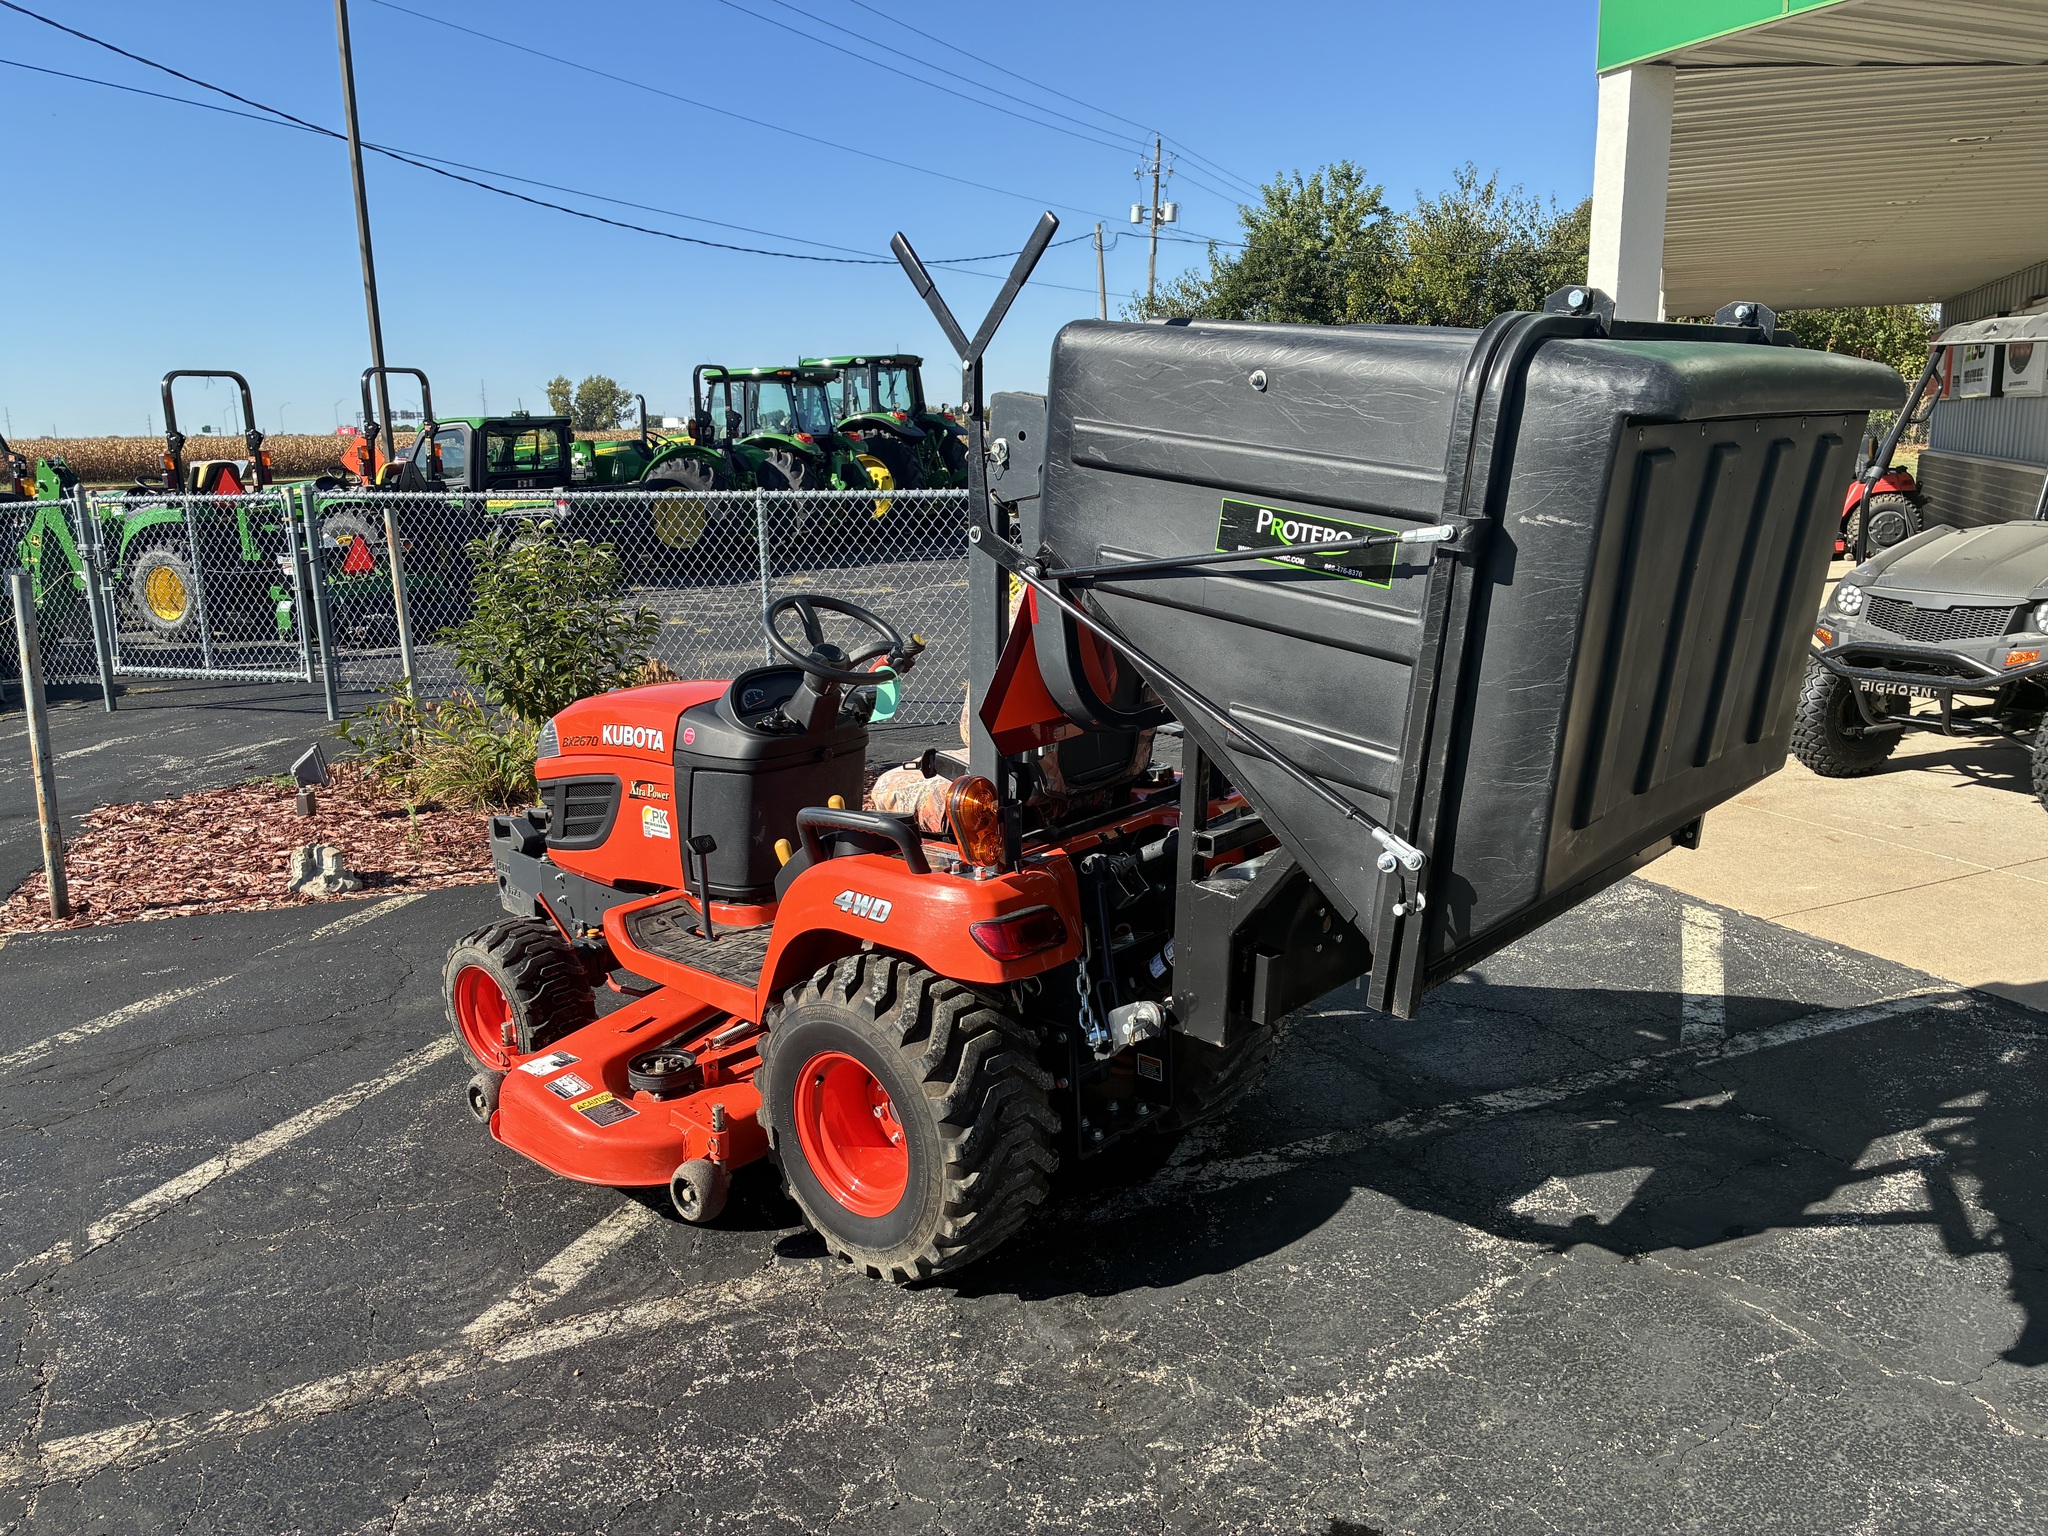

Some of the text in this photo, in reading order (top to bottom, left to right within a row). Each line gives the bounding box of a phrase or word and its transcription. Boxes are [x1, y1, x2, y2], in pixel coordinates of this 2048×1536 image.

[562, 736, 599, 747] BX2670
[602, 725, 665, 753] KUBOTA
[629, 780, 670, 801] Xtra Power
[833, 889, 893, 923] 4WD
